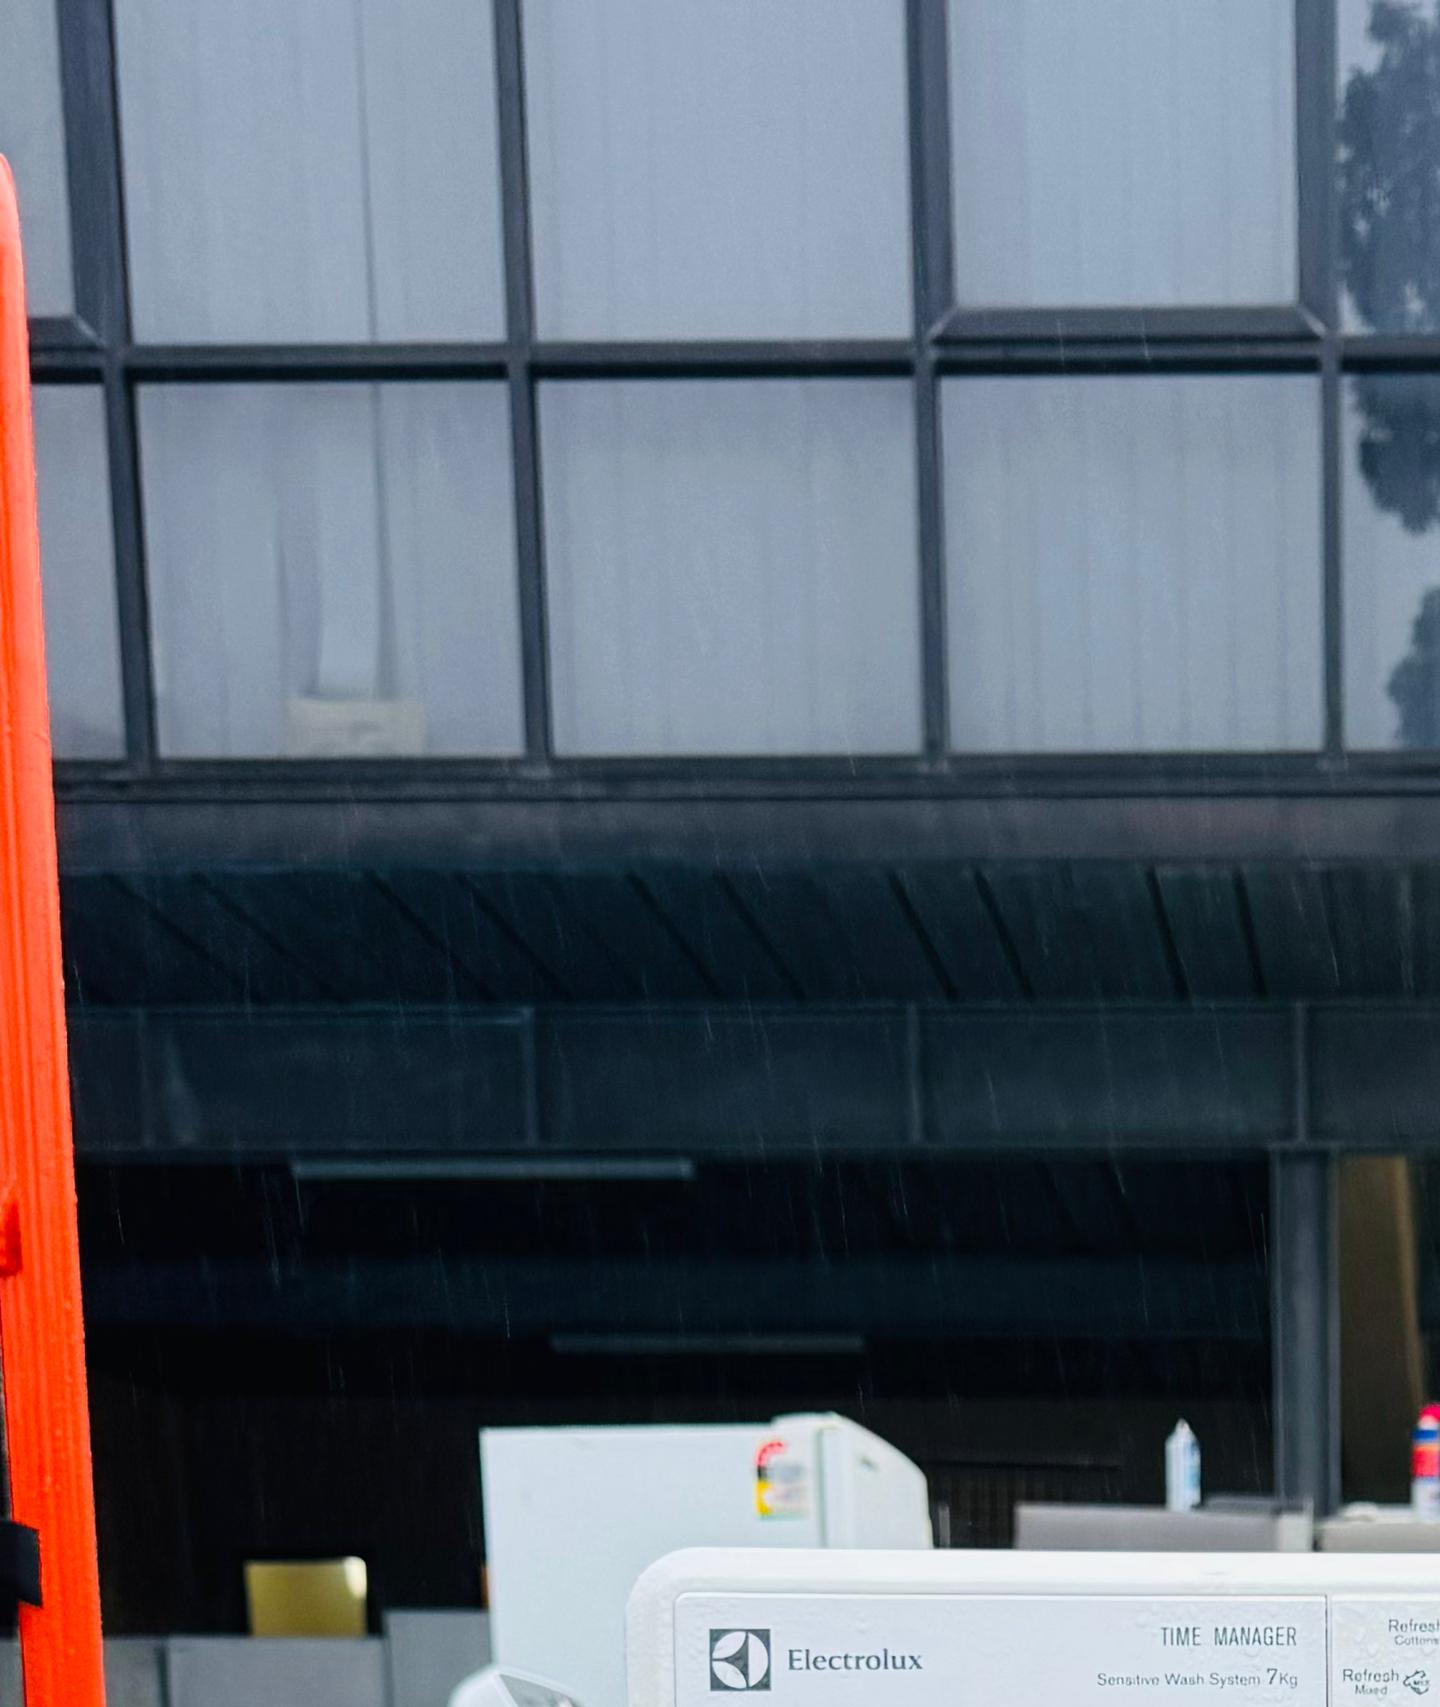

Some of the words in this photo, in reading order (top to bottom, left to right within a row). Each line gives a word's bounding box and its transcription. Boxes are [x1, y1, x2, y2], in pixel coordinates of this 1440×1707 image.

[1160, 1626, 1202, 1646] TIME
[1214, 1626, 1297, 1646] MANAGER
[787, 1647, 924, 1672] Electrolux
[1097, 1673, 1160, 1686] Sensitive
[1165, 1673, 1204, 1685] Wash
[1209, 1673, 1261, 1689] System
[1342, 1668, 1400, 1682] Refresh
